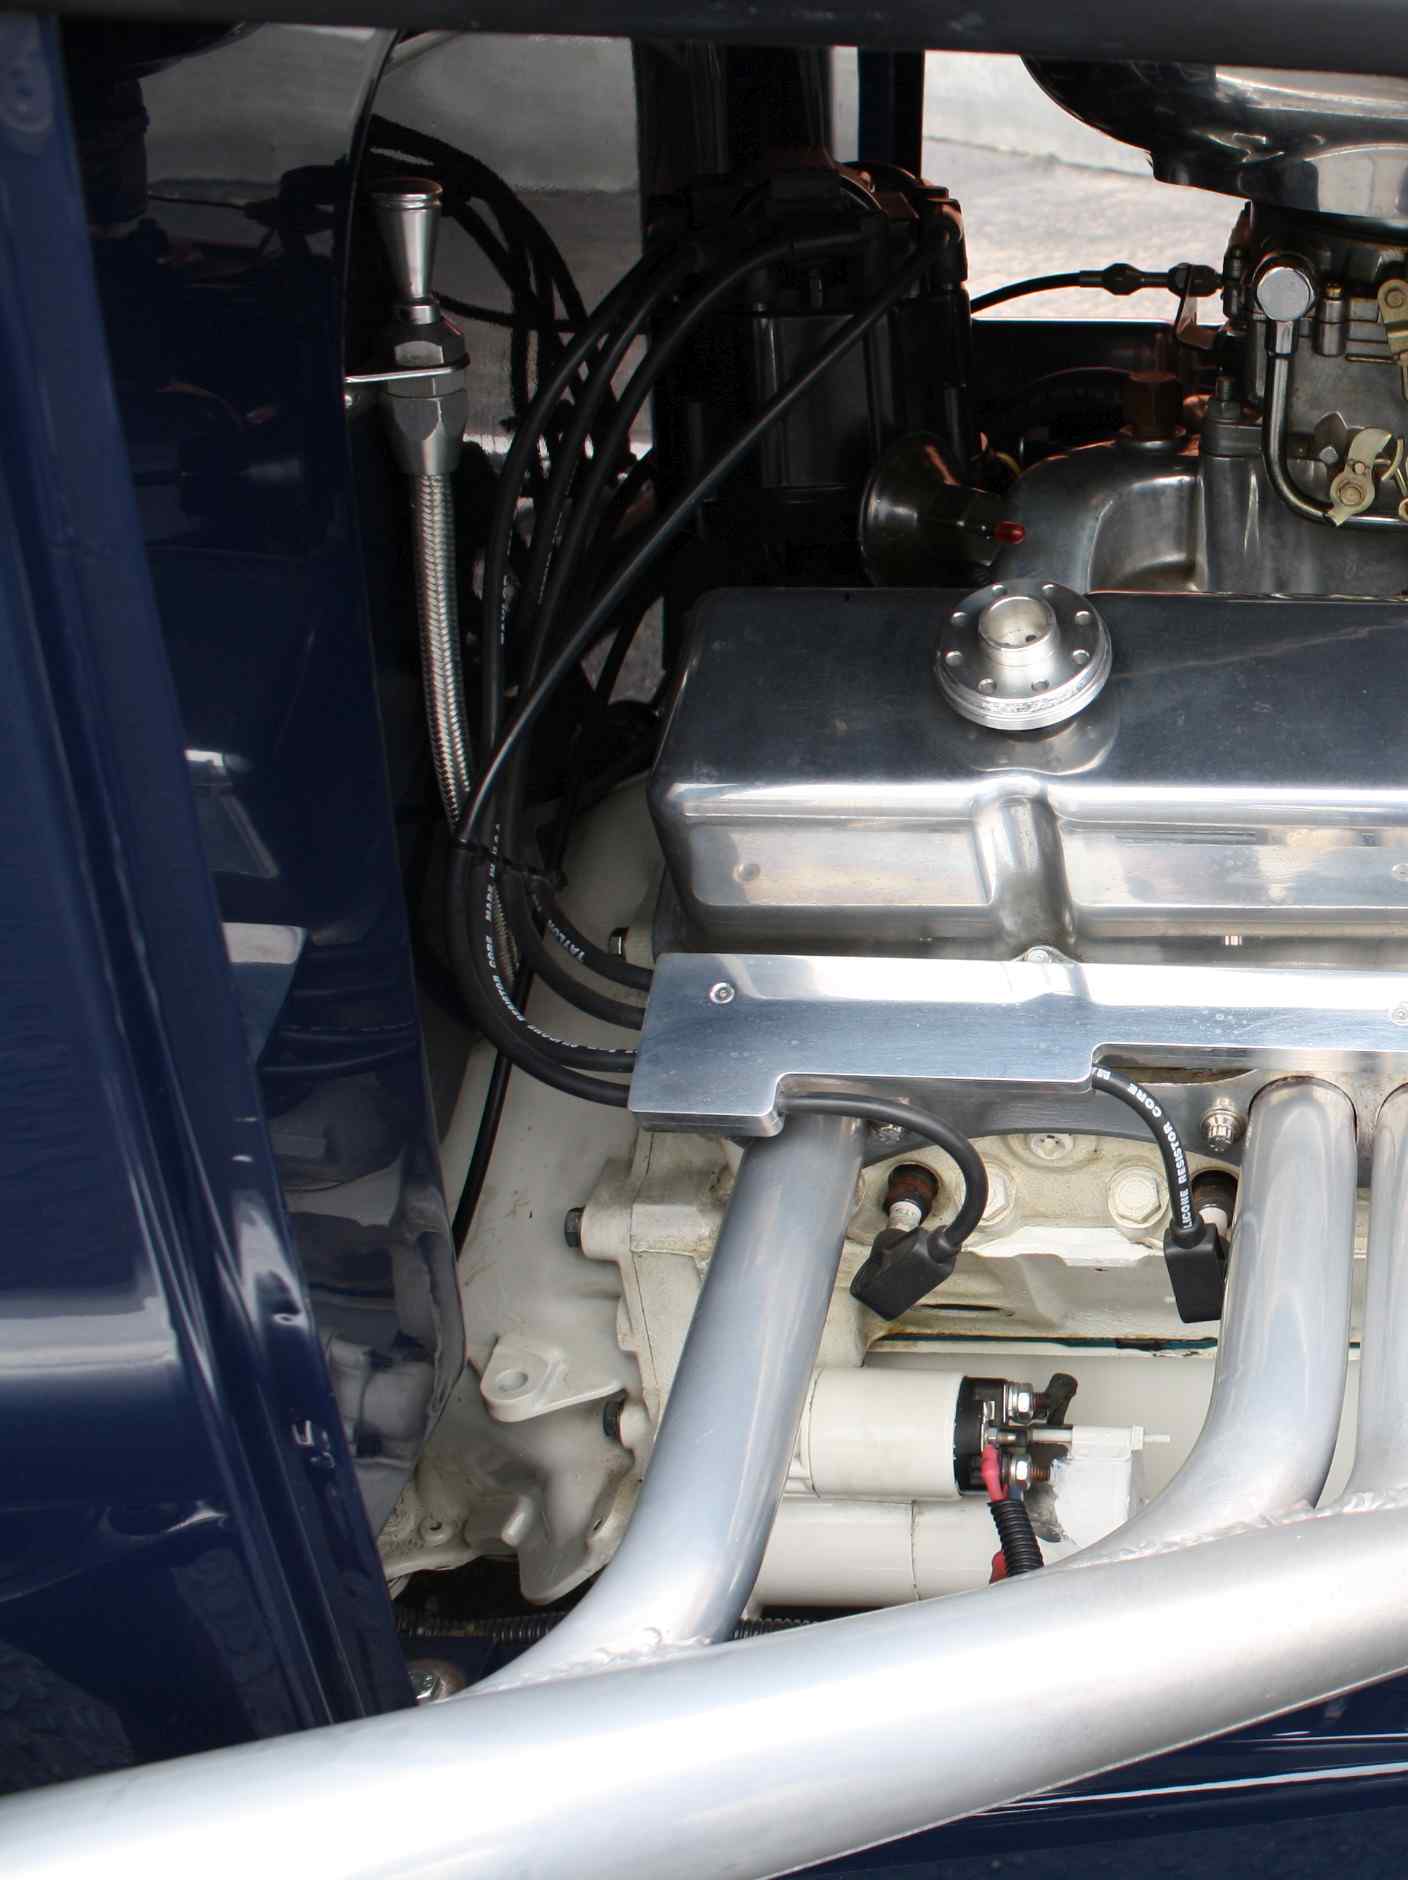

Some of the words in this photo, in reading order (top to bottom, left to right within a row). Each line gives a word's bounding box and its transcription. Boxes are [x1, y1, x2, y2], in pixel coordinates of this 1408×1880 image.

[485, 884, 496, 921] MADE
[485, 935, 497, 969] CORE
[546, 919, 586, 961] TAYLOR
[1127, 1083, 1162, 1117] CORE
[1163, 1121, 1188, 1183] RESISTOR
